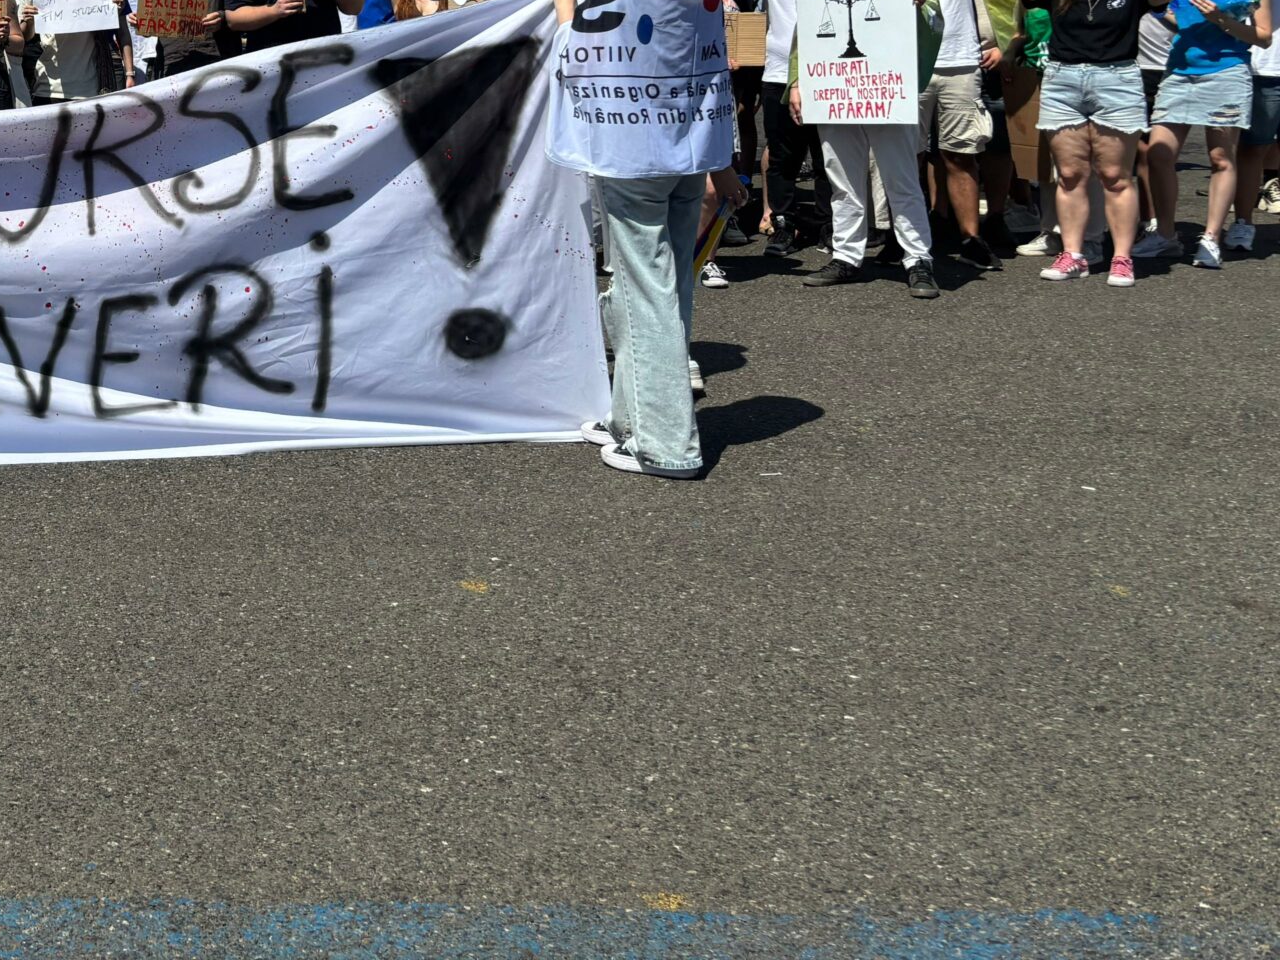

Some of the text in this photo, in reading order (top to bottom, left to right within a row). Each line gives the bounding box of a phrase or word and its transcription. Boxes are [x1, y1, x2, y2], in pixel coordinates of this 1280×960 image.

[806, 60, 827, 77] VOI
[845, 77, 858, 88] NOI
[813, 86, 907, 102] DREPTUL NOSTRU-L
